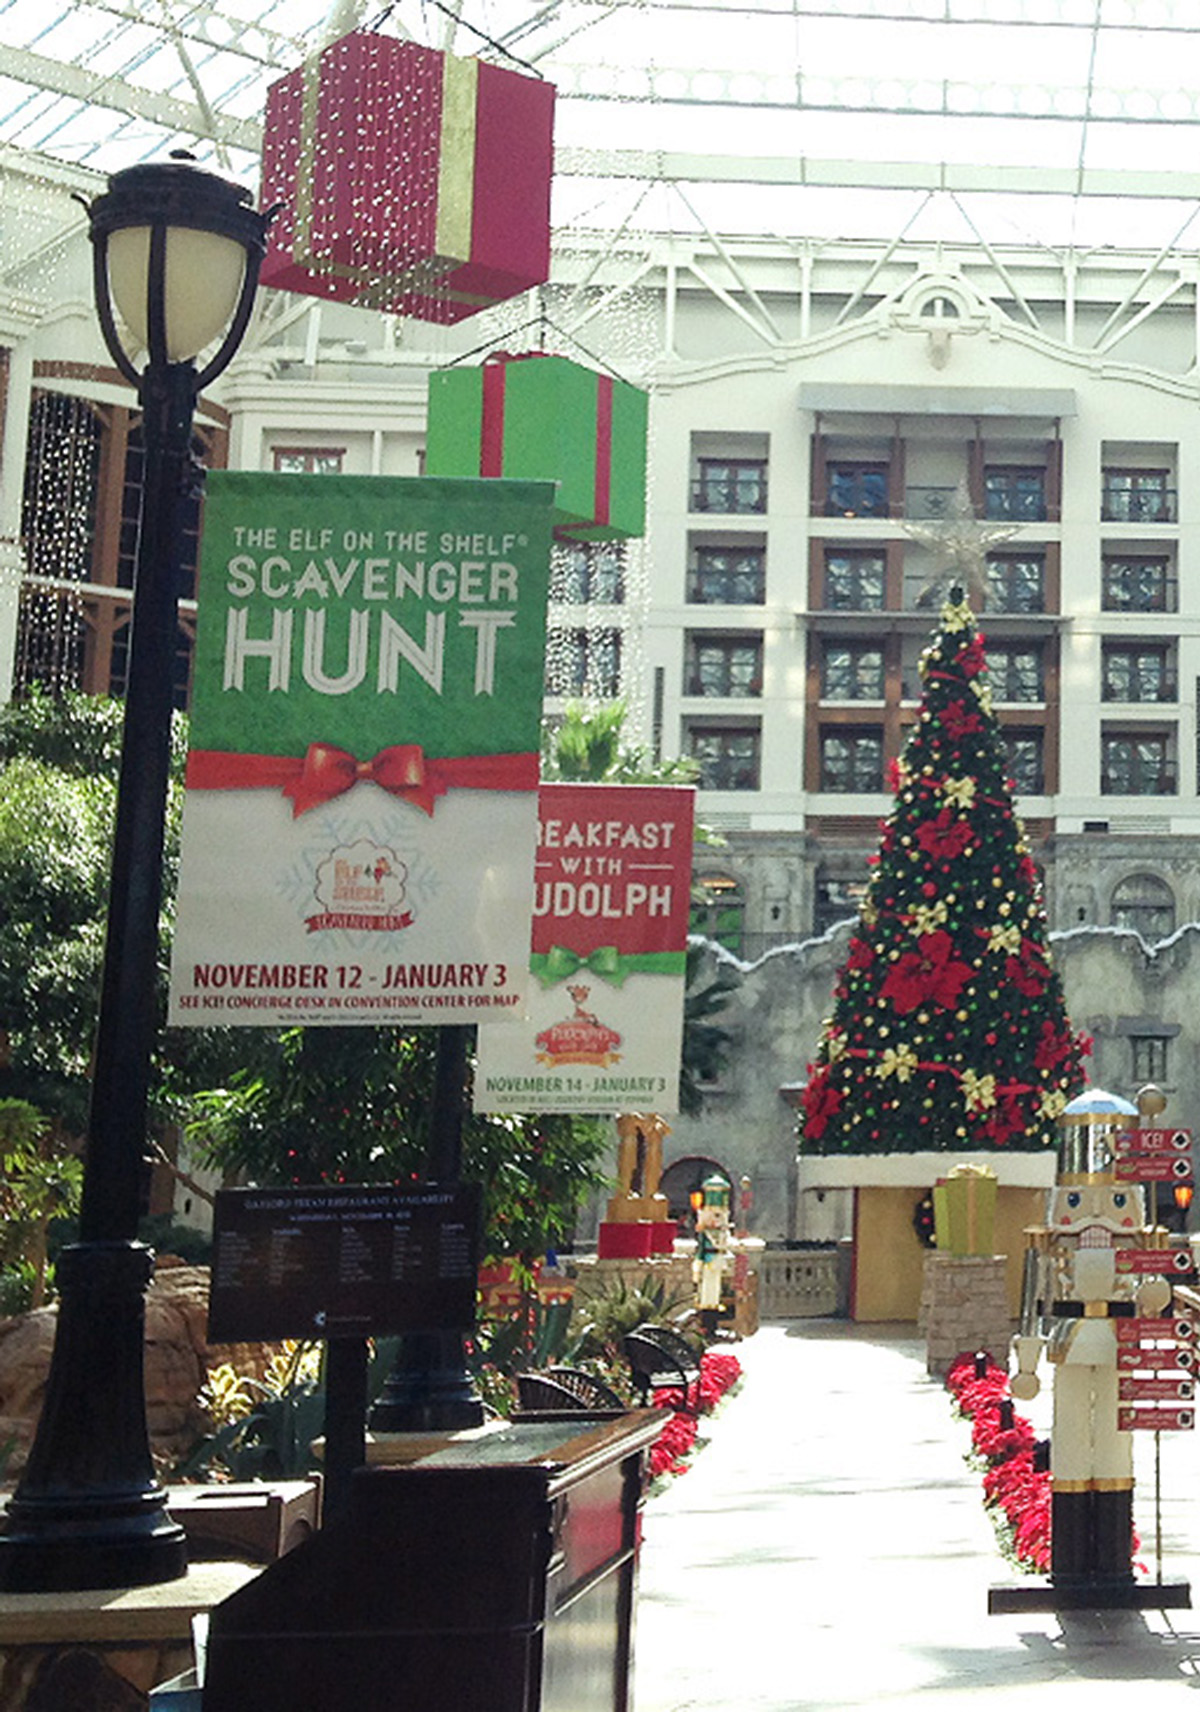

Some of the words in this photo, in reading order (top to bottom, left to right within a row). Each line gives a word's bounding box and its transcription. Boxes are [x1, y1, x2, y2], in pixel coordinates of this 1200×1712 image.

[233, 527, 276, 549] THE
[290, 529, 332, 551] ELF
[344, 530, 372, 551] ON
[384, 531, 428, 553] THE
[226, 555, 519, 602] SCAVENGER
[222, 607, 517, 696] HUNT
[536, 820, 675, 849] EAKFAST
[560, 857, 622, 876] WITH
[532, 882, 672, 918] UDOLPH
[193, 964, 328, 988] NOVEMBER
[336, 965, 362, 988] 12
[381, 964, 488, 988] JANUARY
[493, 964, 507, 987] 3
[179, 995, 199, 1009] SEE
[226, 995, 293, 1009] CONCIERGE
[294, 995, 326, 1009] DESK
[328, 996, 342, 1008] IN
[344, 995, 419, 1009] CONVENTION
[421, 995, 467, 1007] CENTER
[468, 995, 491, 1006] FOR
[493, 995, 520, 1006] MAP
[486, 1077, 563, 1092] NOVEMBER
[567, 1078, 582, 1091] 14
[592, 1077, 656, 1092] JANUARY
[657, 1079, 666, 1091] 3
